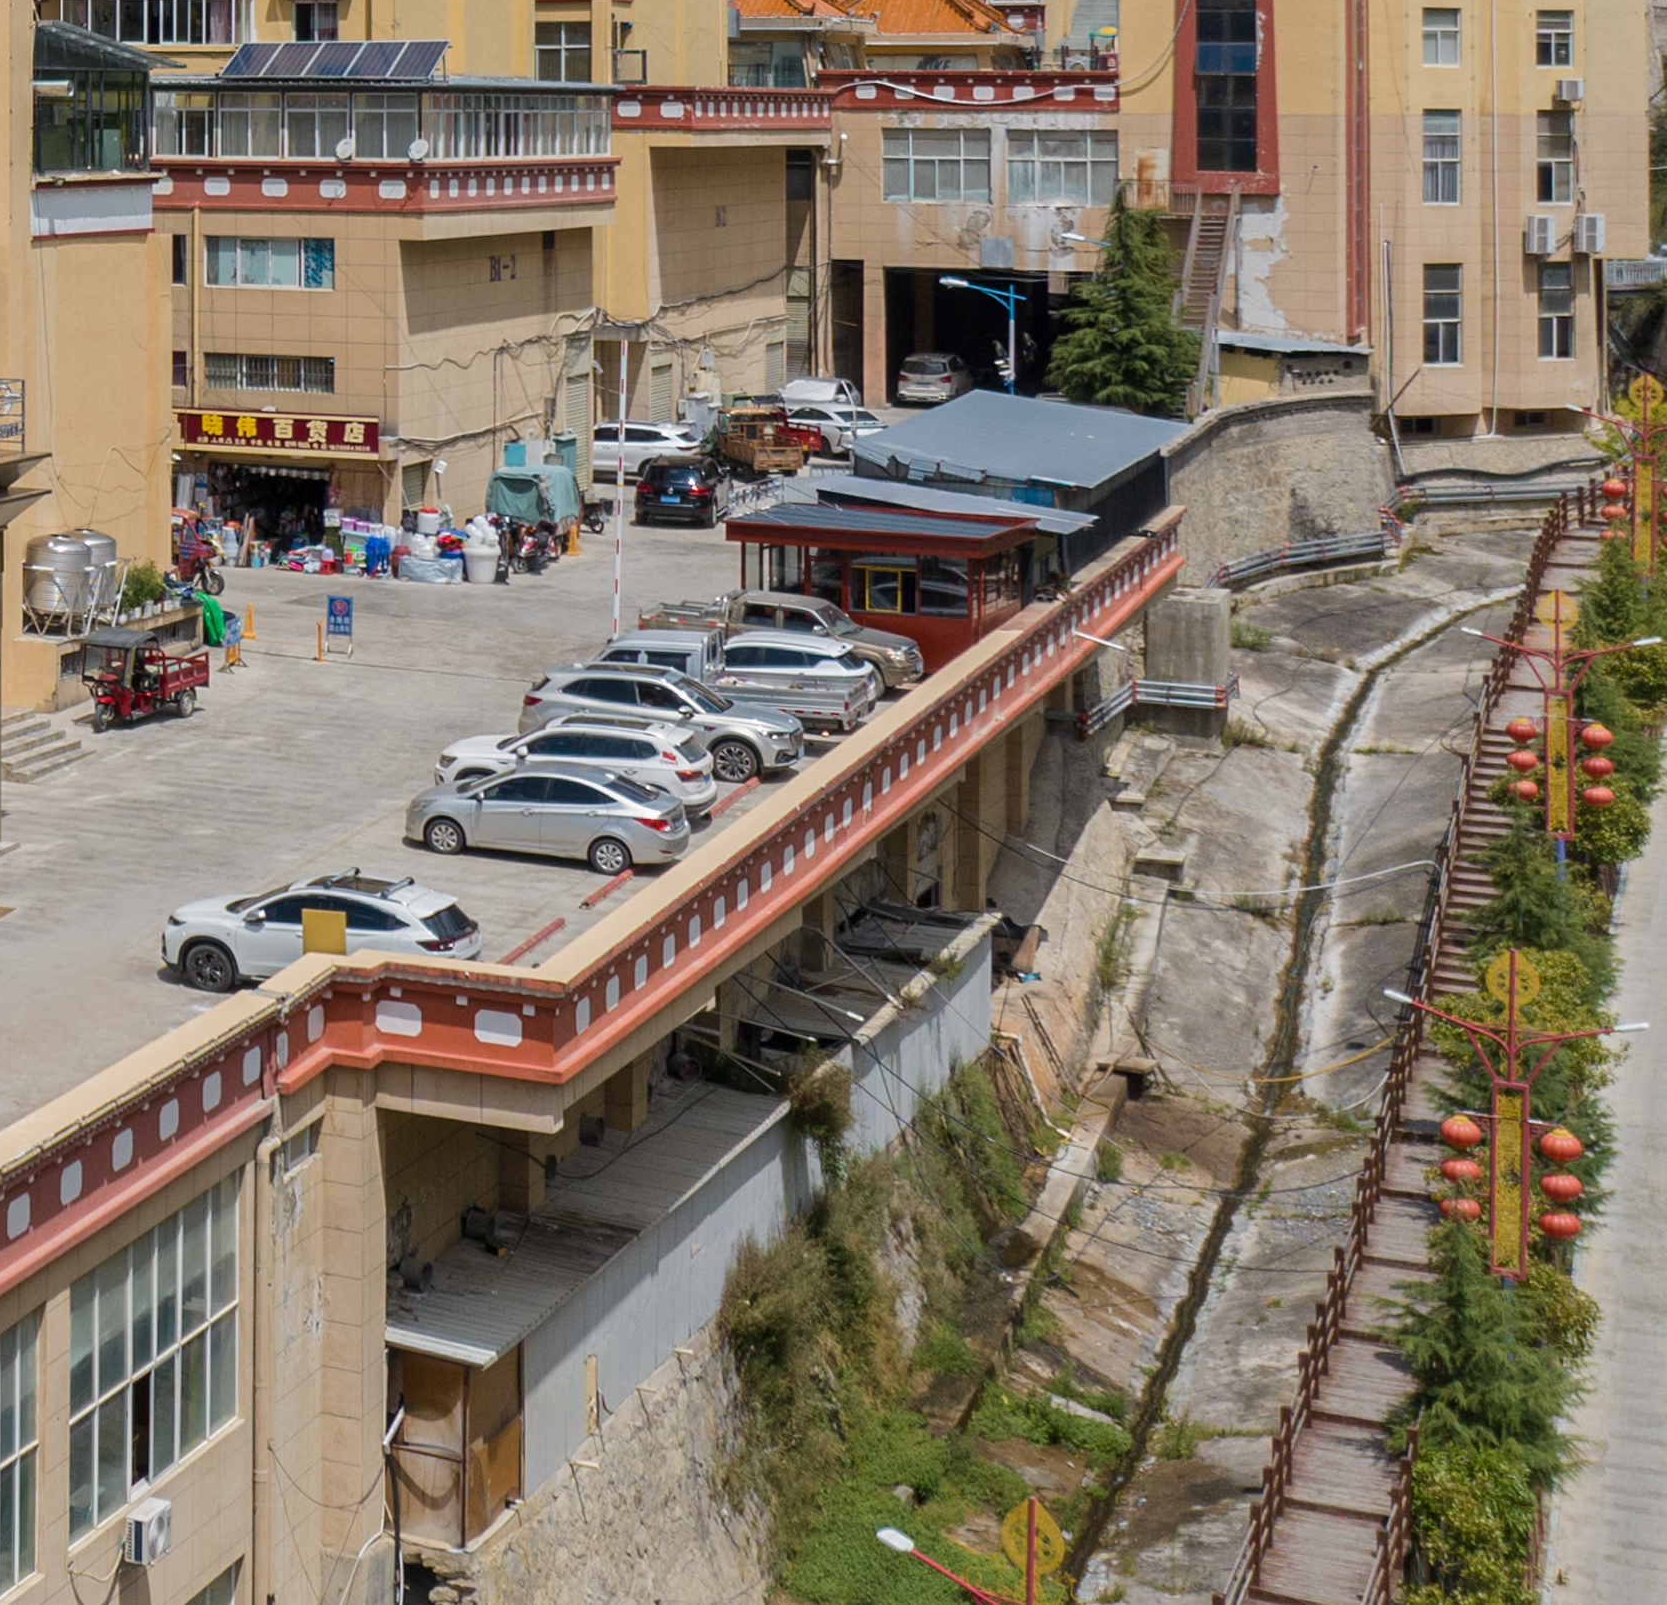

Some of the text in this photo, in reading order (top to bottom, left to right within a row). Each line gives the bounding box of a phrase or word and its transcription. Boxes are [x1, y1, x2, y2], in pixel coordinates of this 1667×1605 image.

[201, 413, 366, 444] 晓伟百货店
